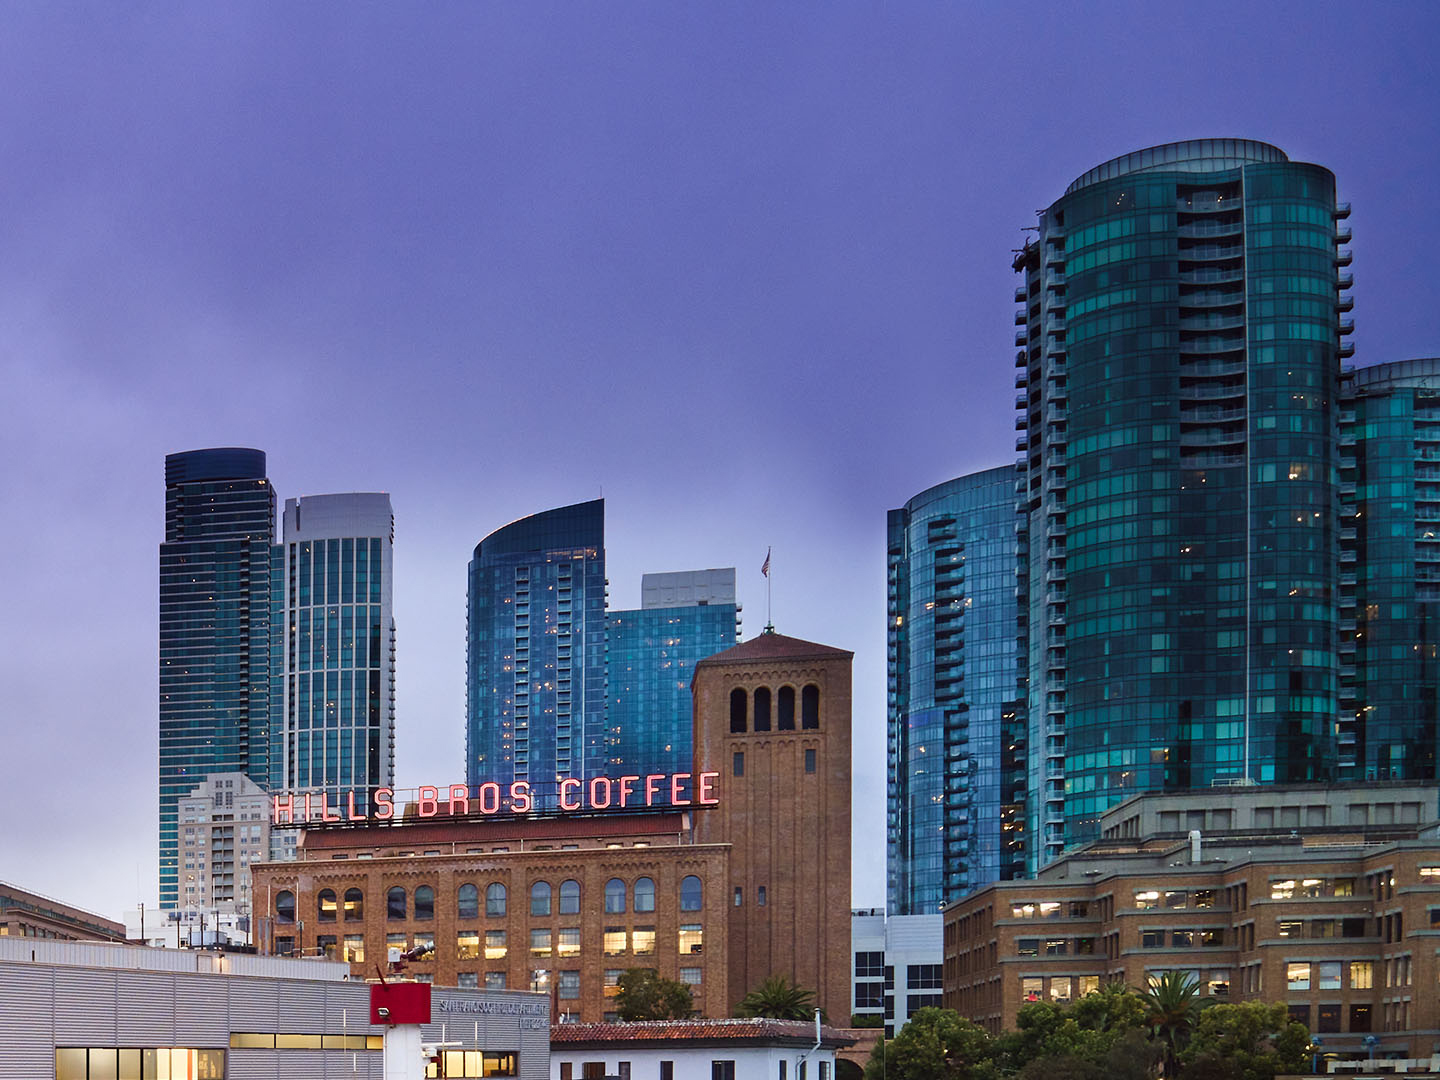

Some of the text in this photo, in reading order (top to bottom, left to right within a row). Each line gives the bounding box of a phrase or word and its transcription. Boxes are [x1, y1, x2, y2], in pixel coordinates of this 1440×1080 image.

[274, 772, 720, 825] HILLS BROS COFFEE
